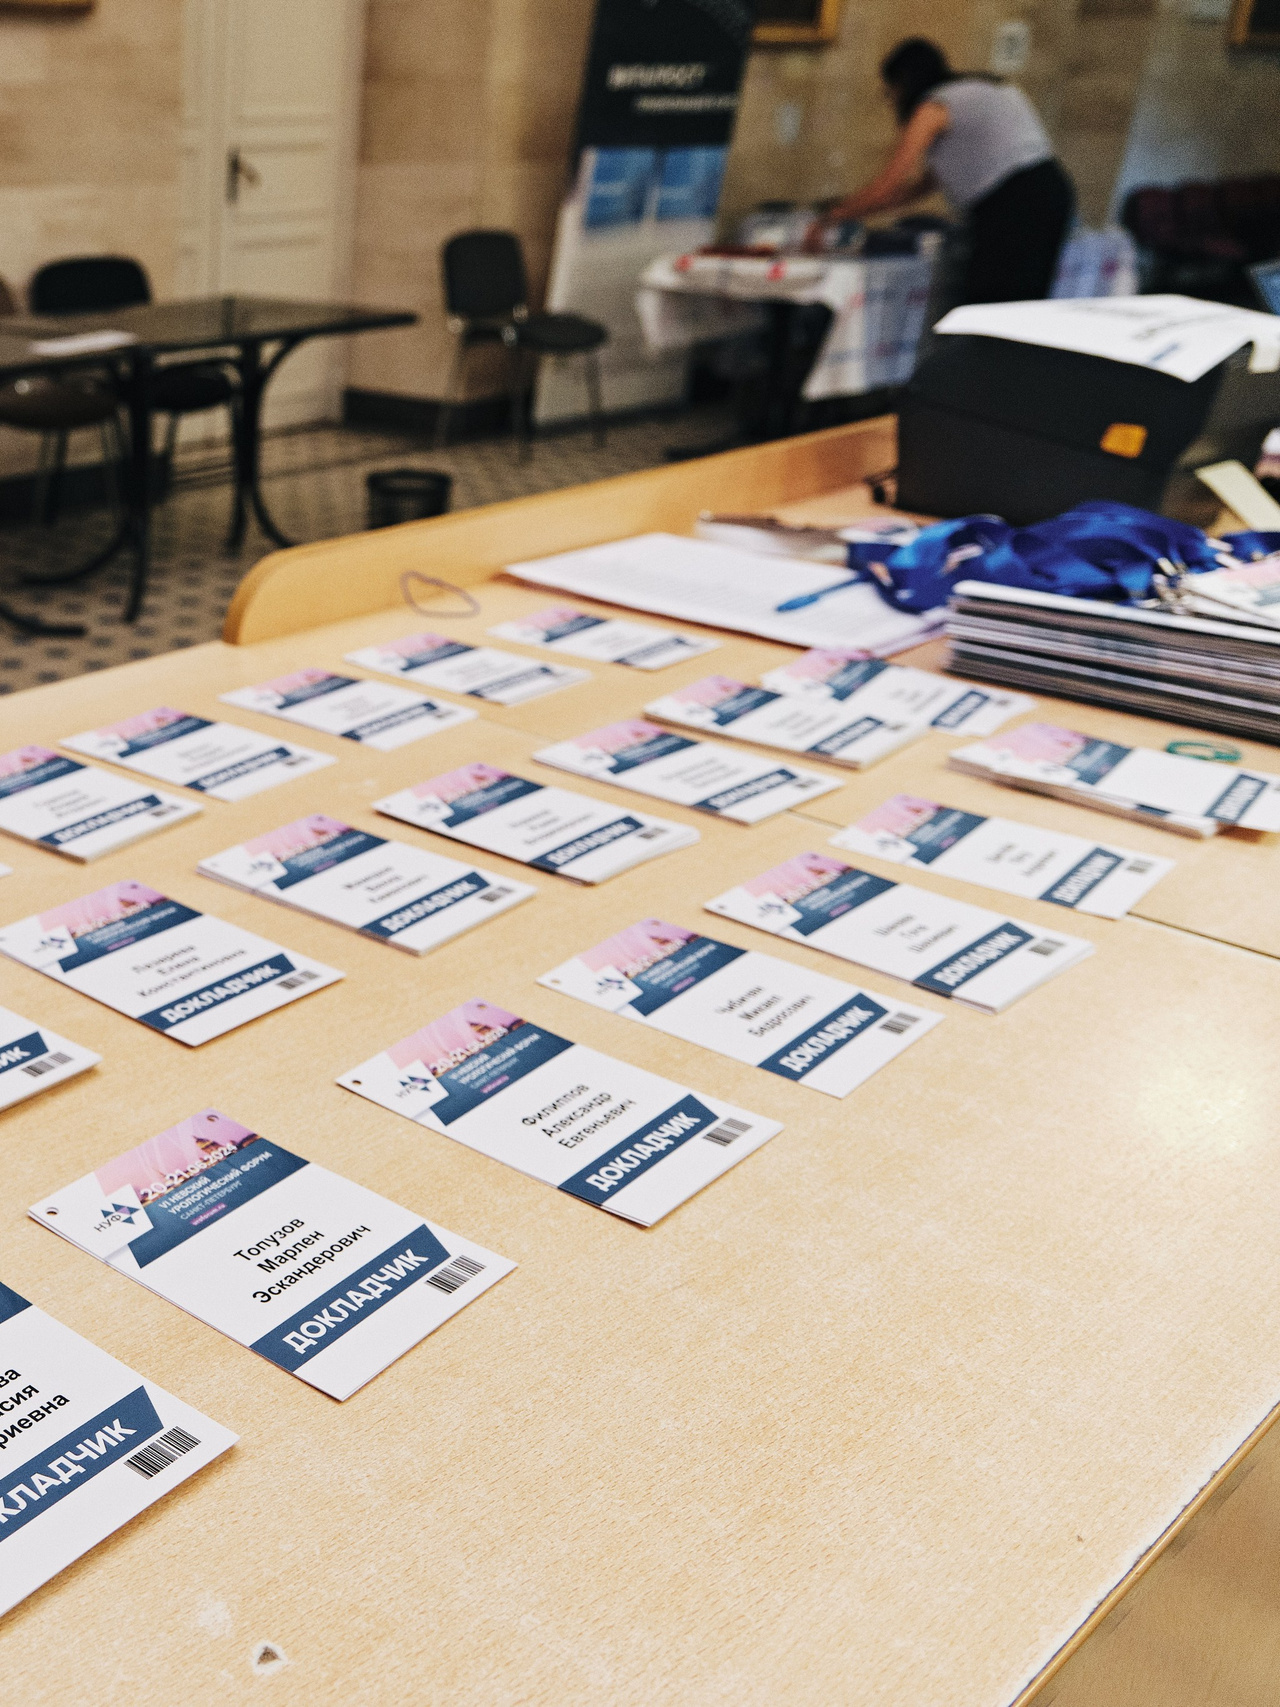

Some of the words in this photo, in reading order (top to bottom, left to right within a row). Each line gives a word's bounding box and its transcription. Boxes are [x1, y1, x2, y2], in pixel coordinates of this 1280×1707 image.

[160, 964, 282, 1023] ДОКЛАДЧИК
[778, 1005, 874, 1073] ДОКЛАДЧИК
[521, 1082, 590, 1127] Филиппов
[541, 1090, 612, 1139] Александр
[558, 1098, 638, 1149] Евгеньевич
[140, 1143, 238, 1200] 20-21.06.2024
[585, 1111, 702, 1192] ДОКЛАДЧИК
[159, 1200, 170, 1209] VI
[170, 1176, 212, 1205] НЕВСКИЙ
[168, 1168, 243, 1214] УРОЛОГИЧЕСКИЙ
[240, 1151, 273, 1172] ФОРУМ
[180, 1180, 242, 1220] САНКТ-ПЕТЕРБУРГ
[94, 1214, 121, 1232] НУФ
[232, 1215, 305, 1264] Топузов
[252, 1223, 371, 1304] Эскандерович
[257, 1229, 325, 1276] Марлен
[282, 1248, 429, 1355] ДОКЛАДЧИК
